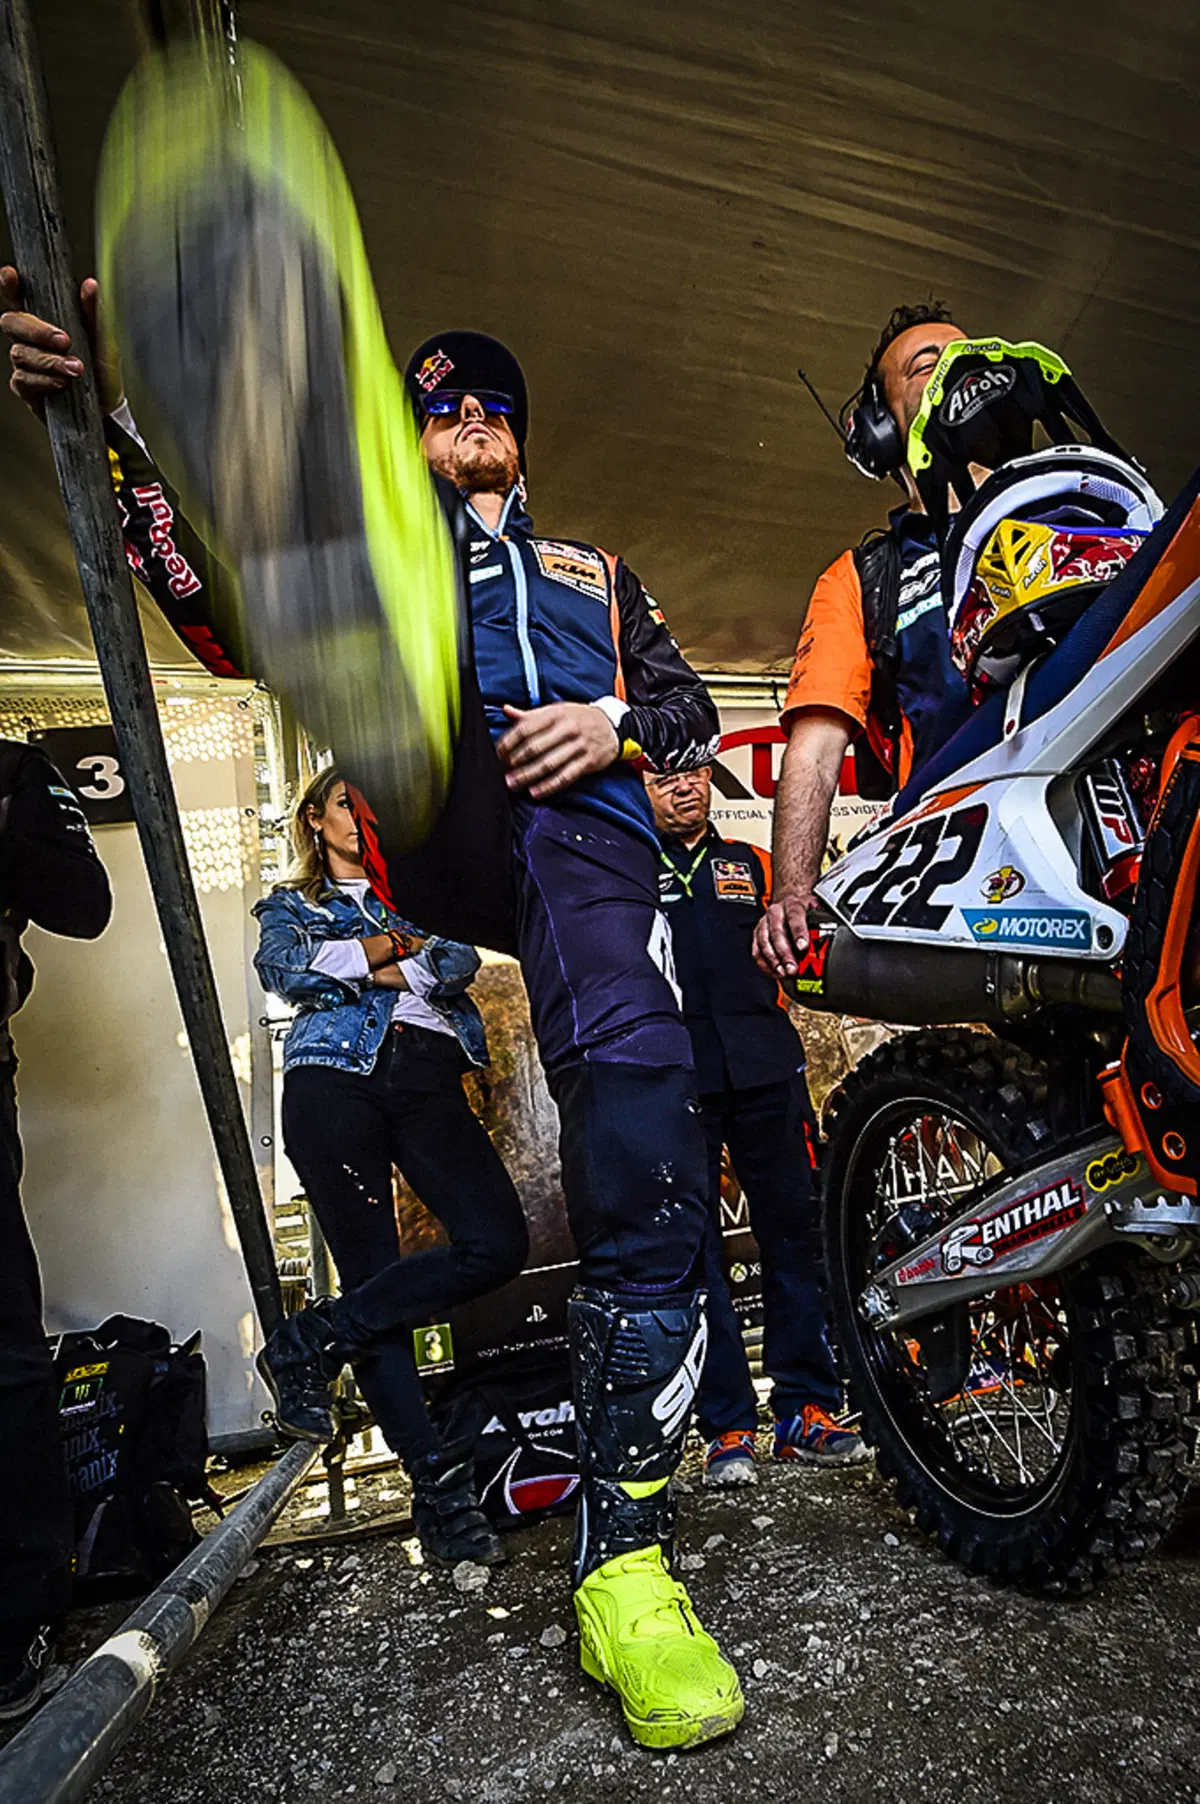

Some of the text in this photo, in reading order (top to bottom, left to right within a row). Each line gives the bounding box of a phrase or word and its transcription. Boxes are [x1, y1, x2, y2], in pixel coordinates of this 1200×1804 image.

[948, 370, 1010, 422] Airoh
[131, 482, 202, 600] Red Bull
[75, 755, 125, 800] 3
[837, 802, 989, 932] 222
[998, 916, 1086, 940] MOTOREX
[424, 1330, 444, 1363] 3
